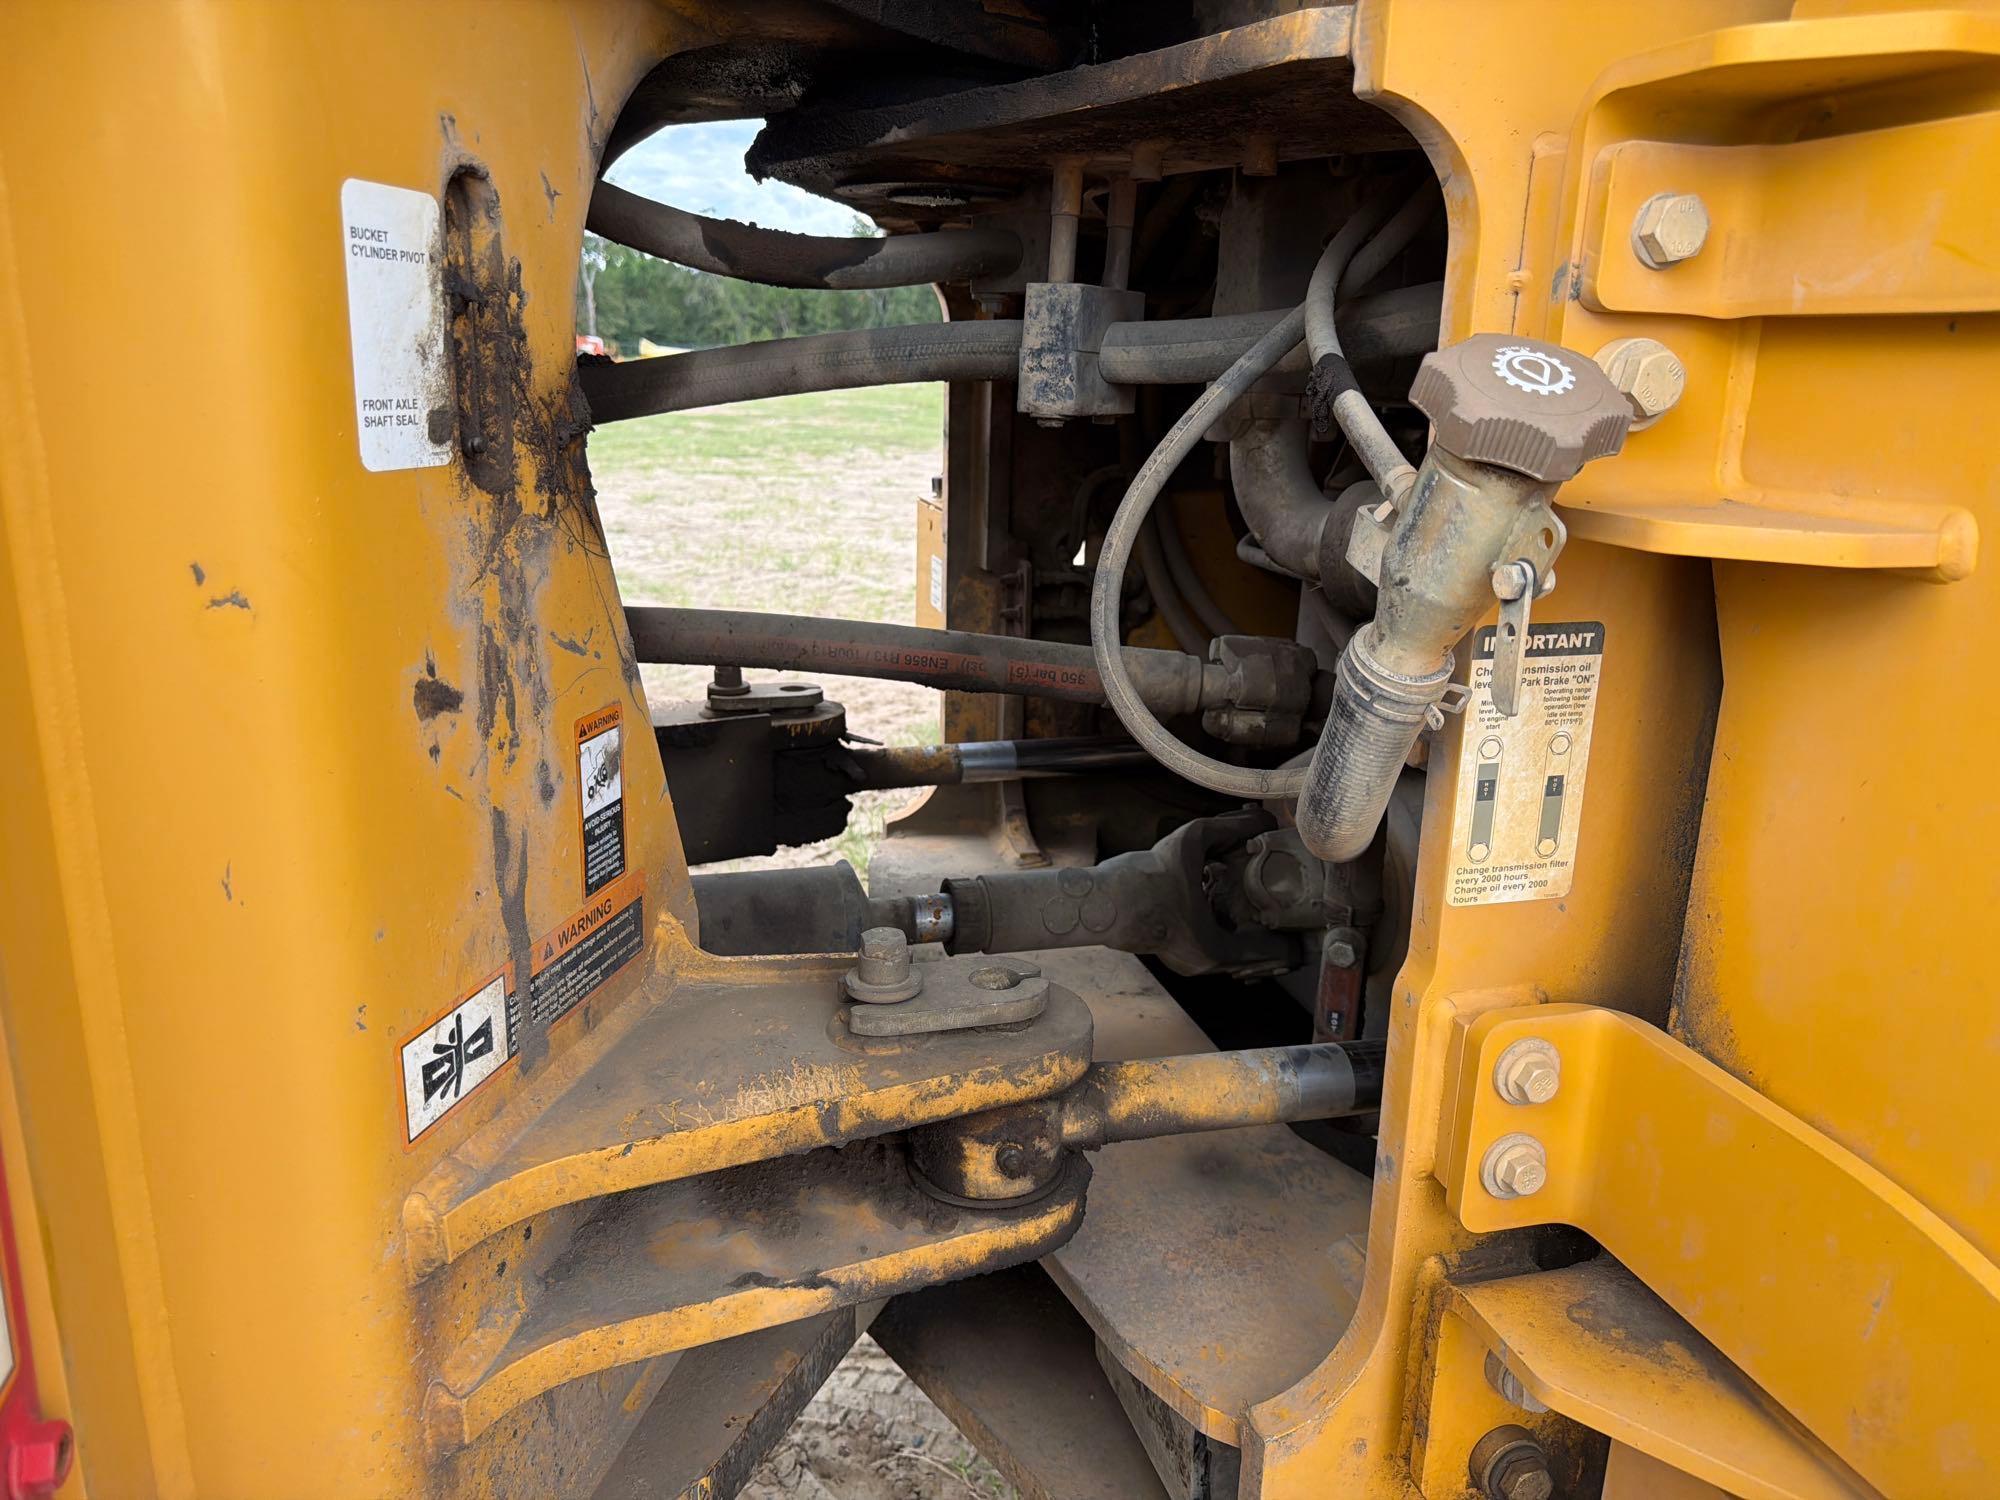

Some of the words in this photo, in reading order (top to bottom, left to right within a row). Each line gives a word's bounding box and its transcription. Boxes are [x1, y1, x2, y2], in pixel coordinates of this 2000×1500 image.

[350, 226, 388, 243] BUCKET
[352, 244, 398, 261] CYLINDER
[400, 250, 425, 264] PIVOT
[362, 399, 393, 411] FRONT
[396, 399, 418, 410] AXLE
[364, 415, 393, 428] SHAFT
[396, 414, 418, 426] SEAL
[1483, 632, 1595, 652] IORTANT
[904, 653, 949, 672] EN856
[1579, 663, 1591, 672] oil
[1033, 668, 1058, 683] bar
[1061, 670, 1087, 686] 350
[1520, 677, 1541, 687] Park
[1544, 676, 1570, 686] Brake
[587, 710, 619, 733] WARNING
[1456, 867, 1490, 876] Change
[1492, 862, 1547, 873] transmission
[1549, 860, 1569, 868] filter
[1455, 877, 1479, 885] every
[1481, 874, 1502, 883] 2000
[1454, 886, 1488, 895] Change
[1490, 884, 1501, 892] oil
[1502, 883, 1526, 891] every
[1528, 880, 1548, 889] 2000
[1453, 895, 1478, 904] hours
[558, 898, 612, 948] WARNING
